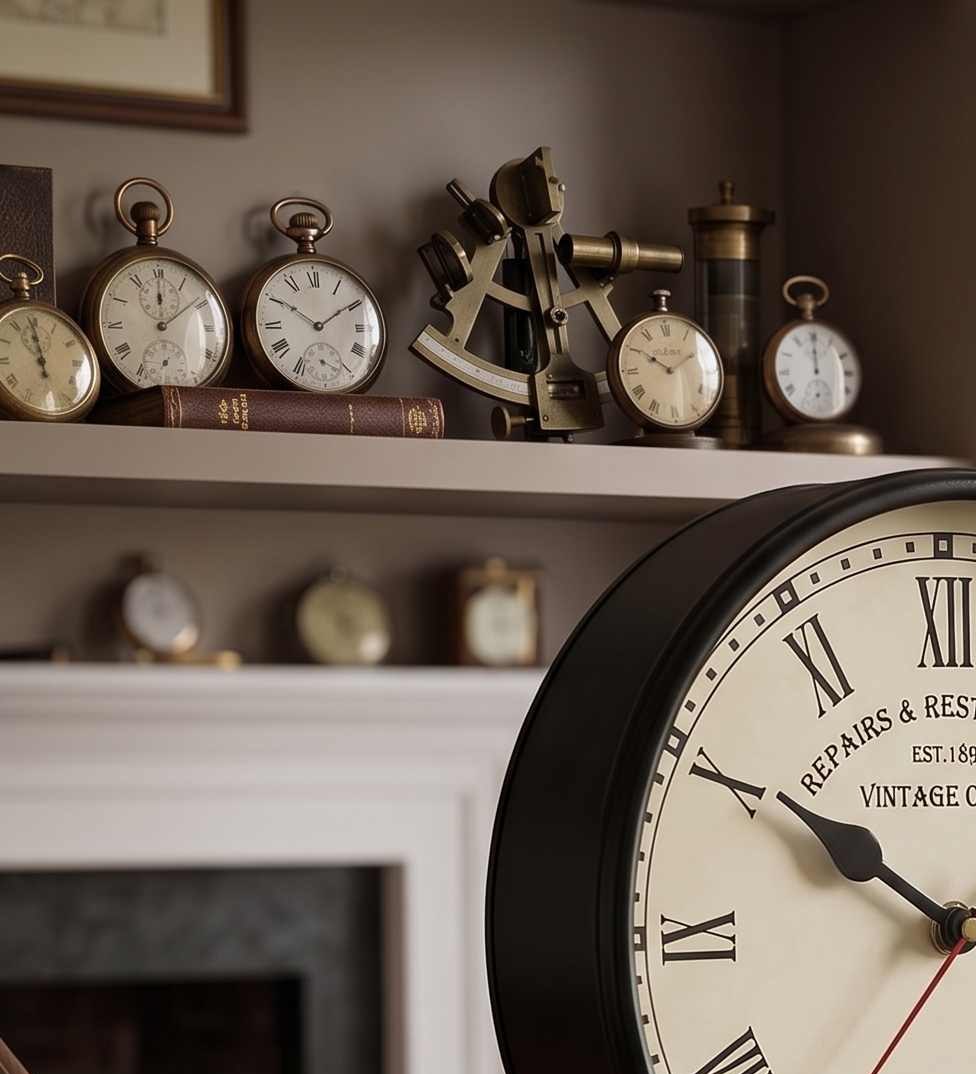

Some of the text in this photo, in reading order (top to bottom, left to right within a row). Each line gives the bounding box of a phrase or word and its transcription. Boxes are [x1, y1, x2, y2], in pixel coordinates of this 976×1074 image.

[915, 576, 975, 668] XII
[782, 612, 856, 719] XI
[688, 746, 767, 820] X
[799, 707, 894, 797] REPAIRS
[898, 698, 918, 724] &
[859, 783, 960, 808] VINTAGE
[660, 909, 737, 967] IX
